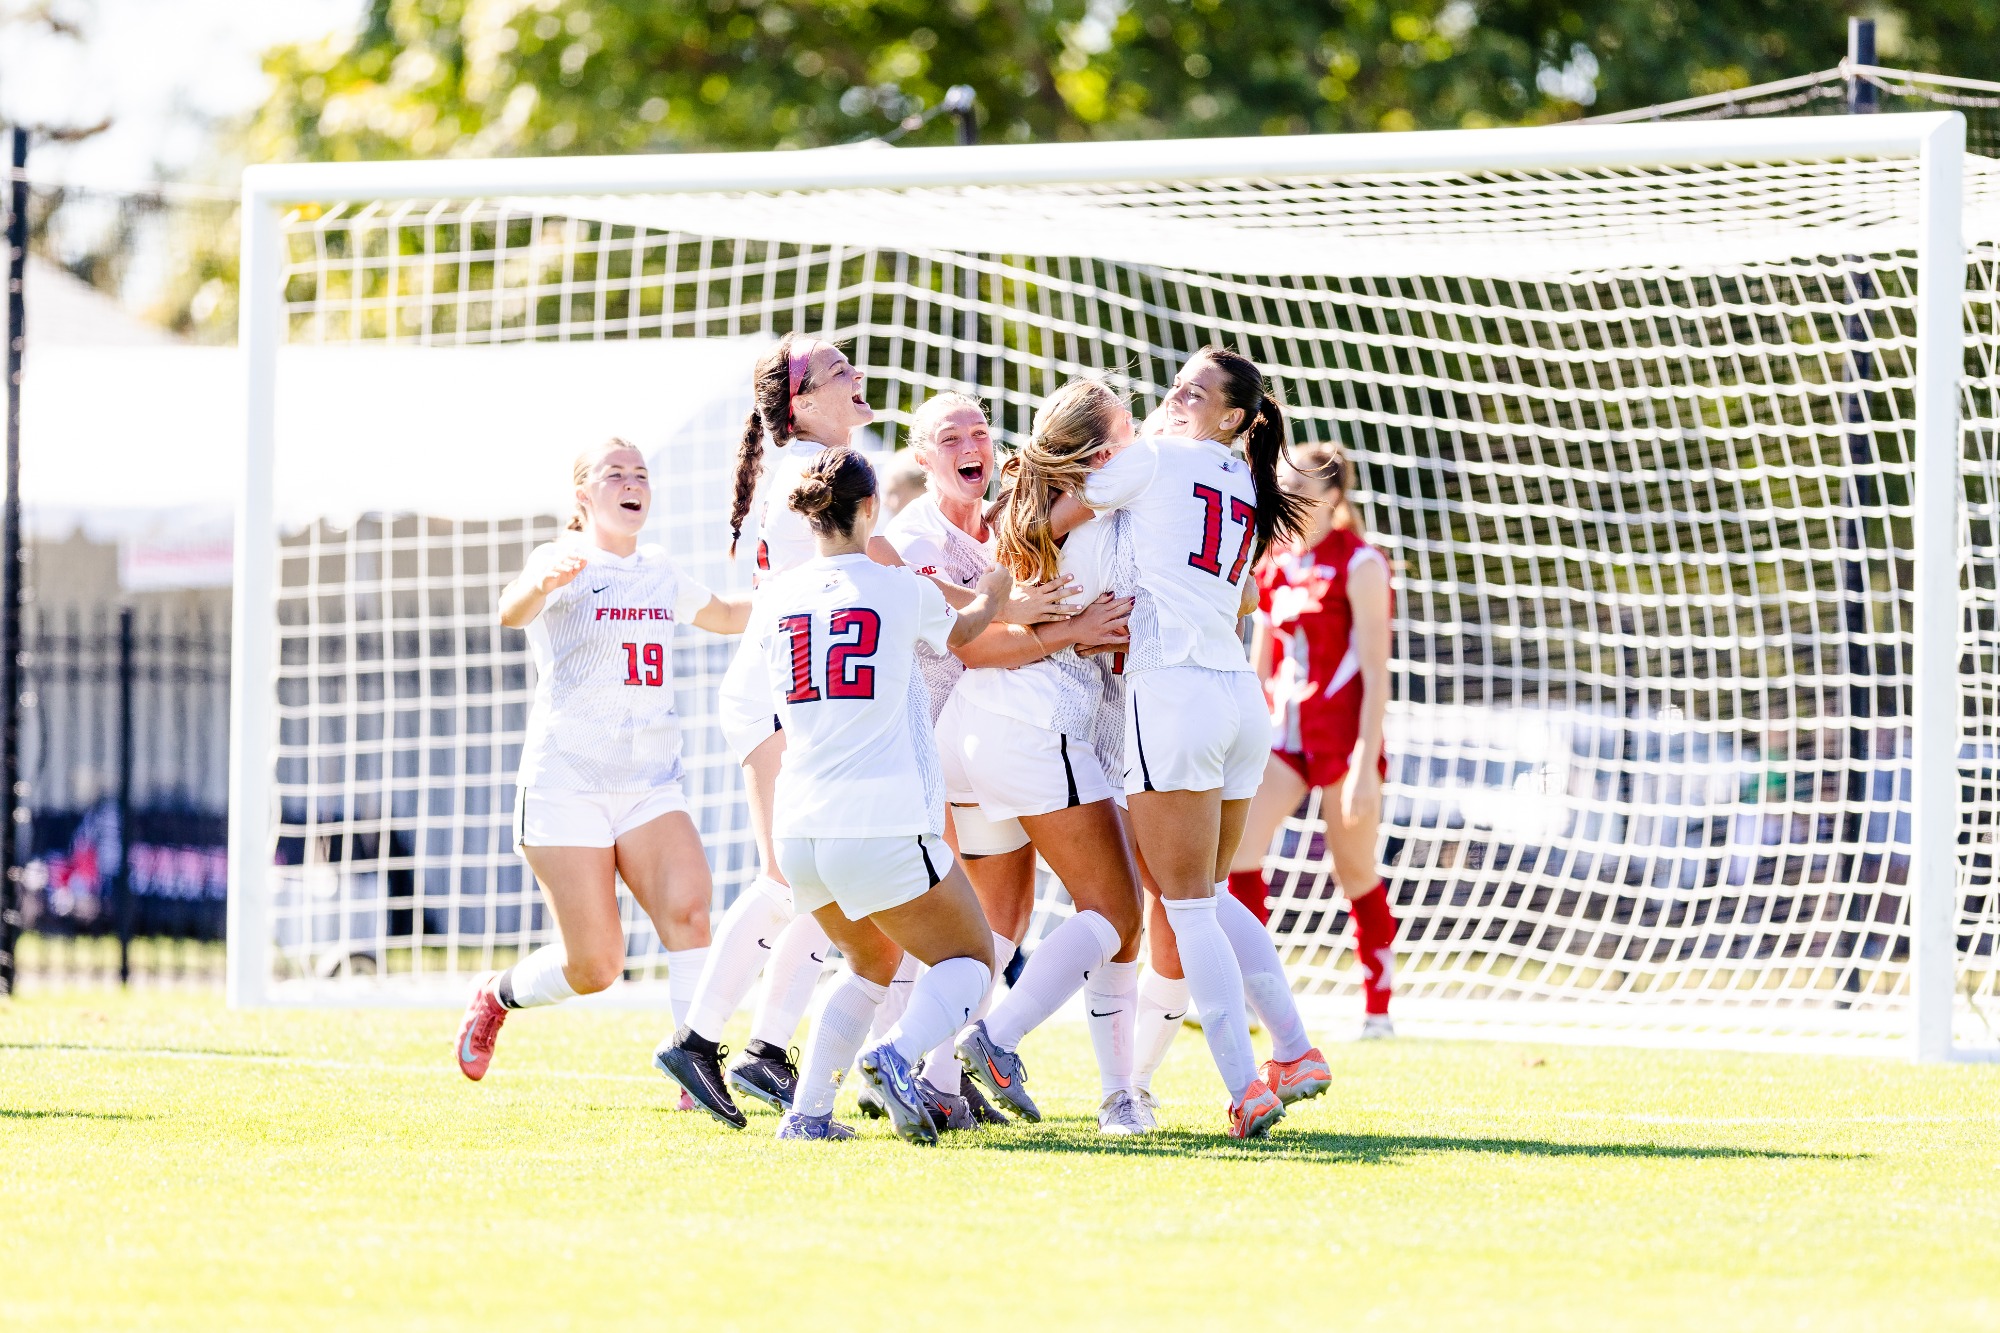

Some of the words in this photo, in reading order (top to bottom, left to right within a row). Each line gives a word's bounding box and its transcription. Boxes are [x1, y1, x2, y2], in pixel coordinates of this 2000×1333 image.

[1188, 482, 1257, 586] 17
[595, 607, 674, 621] FAIRFIEL
[622, 642, 663, 687] 19
[779, 607, 881, 704] 12
